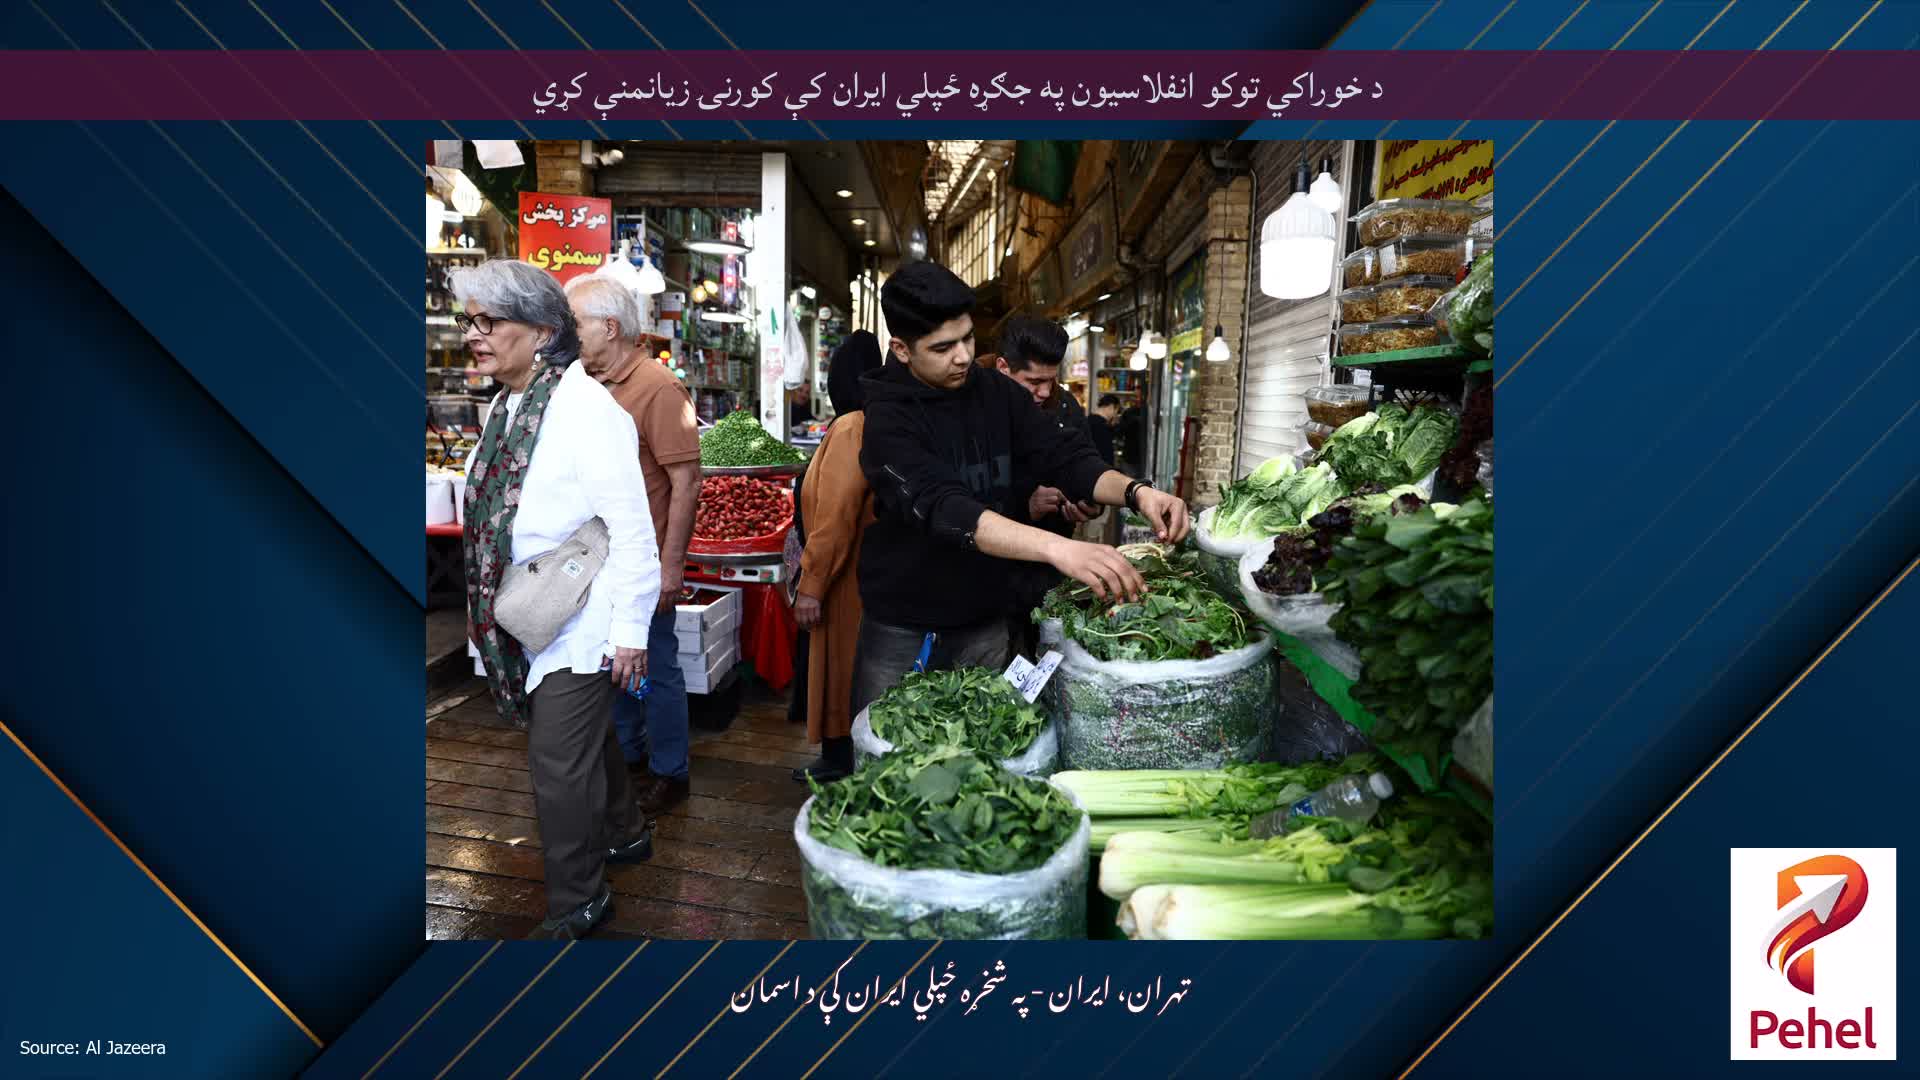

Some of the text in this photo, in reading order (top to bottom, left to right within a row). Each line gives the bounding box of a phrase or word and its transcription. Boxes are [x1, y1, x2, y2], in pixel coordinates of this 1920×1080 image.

[523, 202, 607, 229] مرکز پخش
[528, 243, 602, 271] سمنوی
